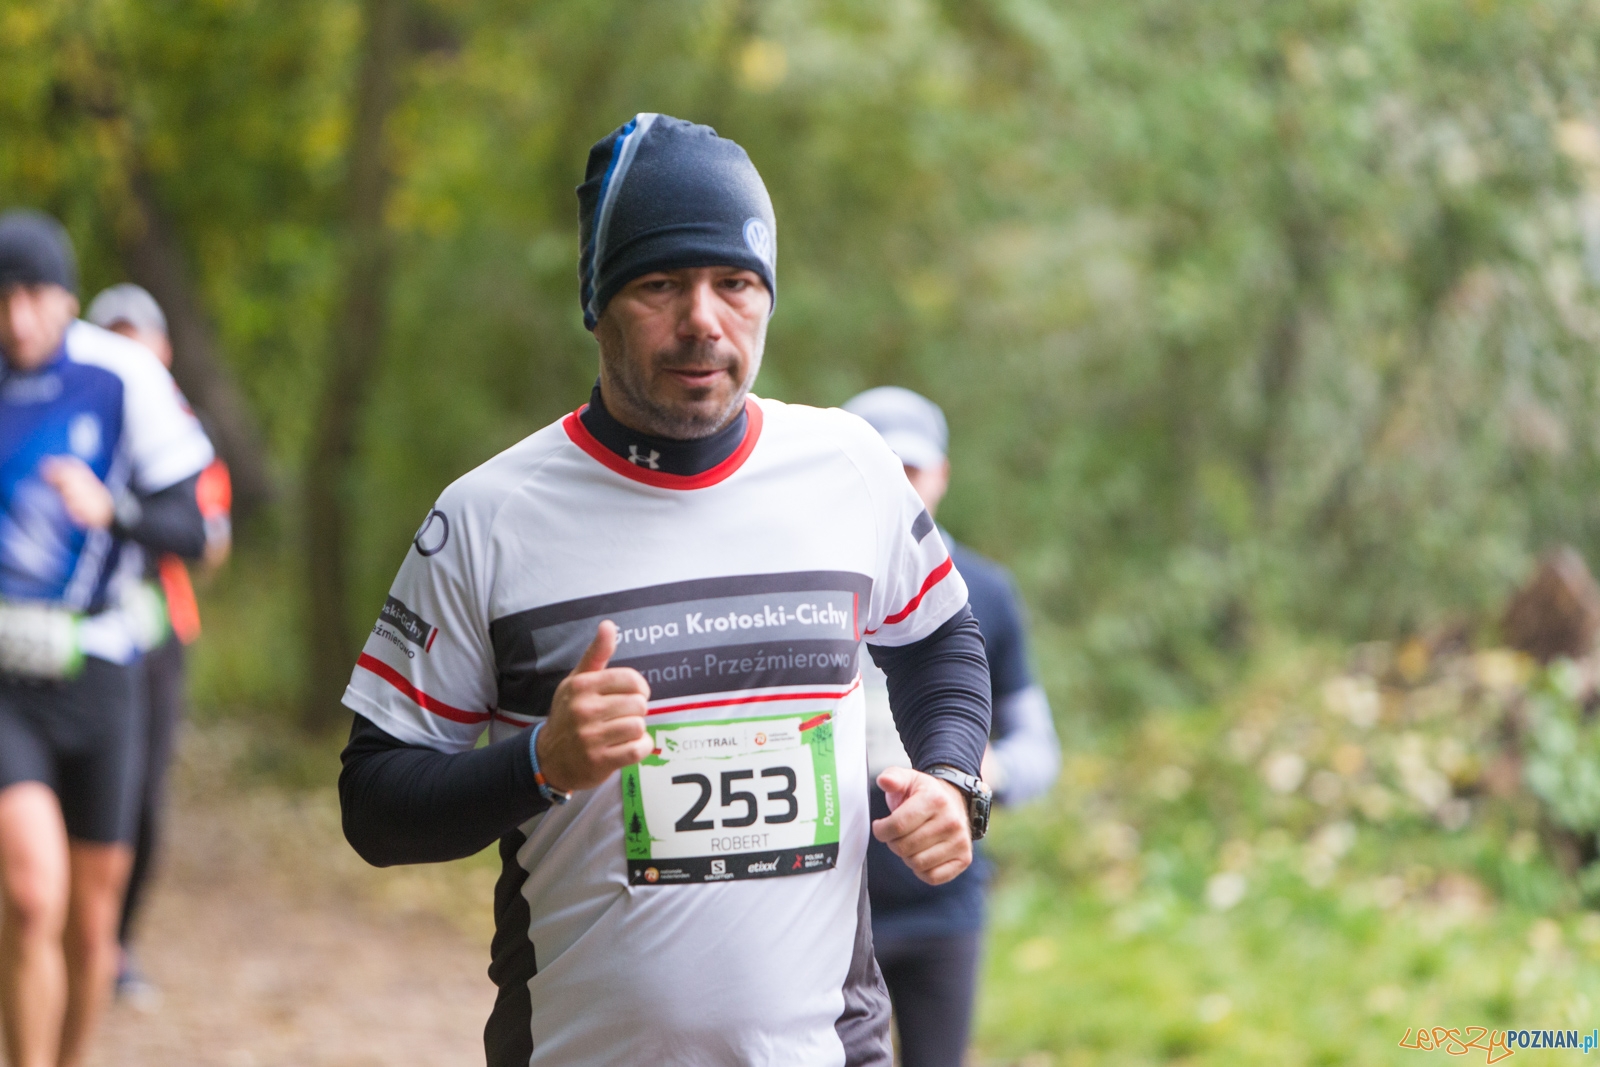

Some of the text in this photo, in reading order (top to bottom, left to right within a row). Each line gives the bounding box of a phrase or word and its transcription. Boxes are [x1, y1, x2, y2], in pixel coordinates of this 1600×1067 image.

[685, 602, 848, 635] Krotoski-Cichy
[641, 647, 850, 684] nań-Przeźmierowo
[671, 765, 798, 833] 253
[819, 773, 834, 827] Poznań
[711, 833, 770, 852] ROBERT
